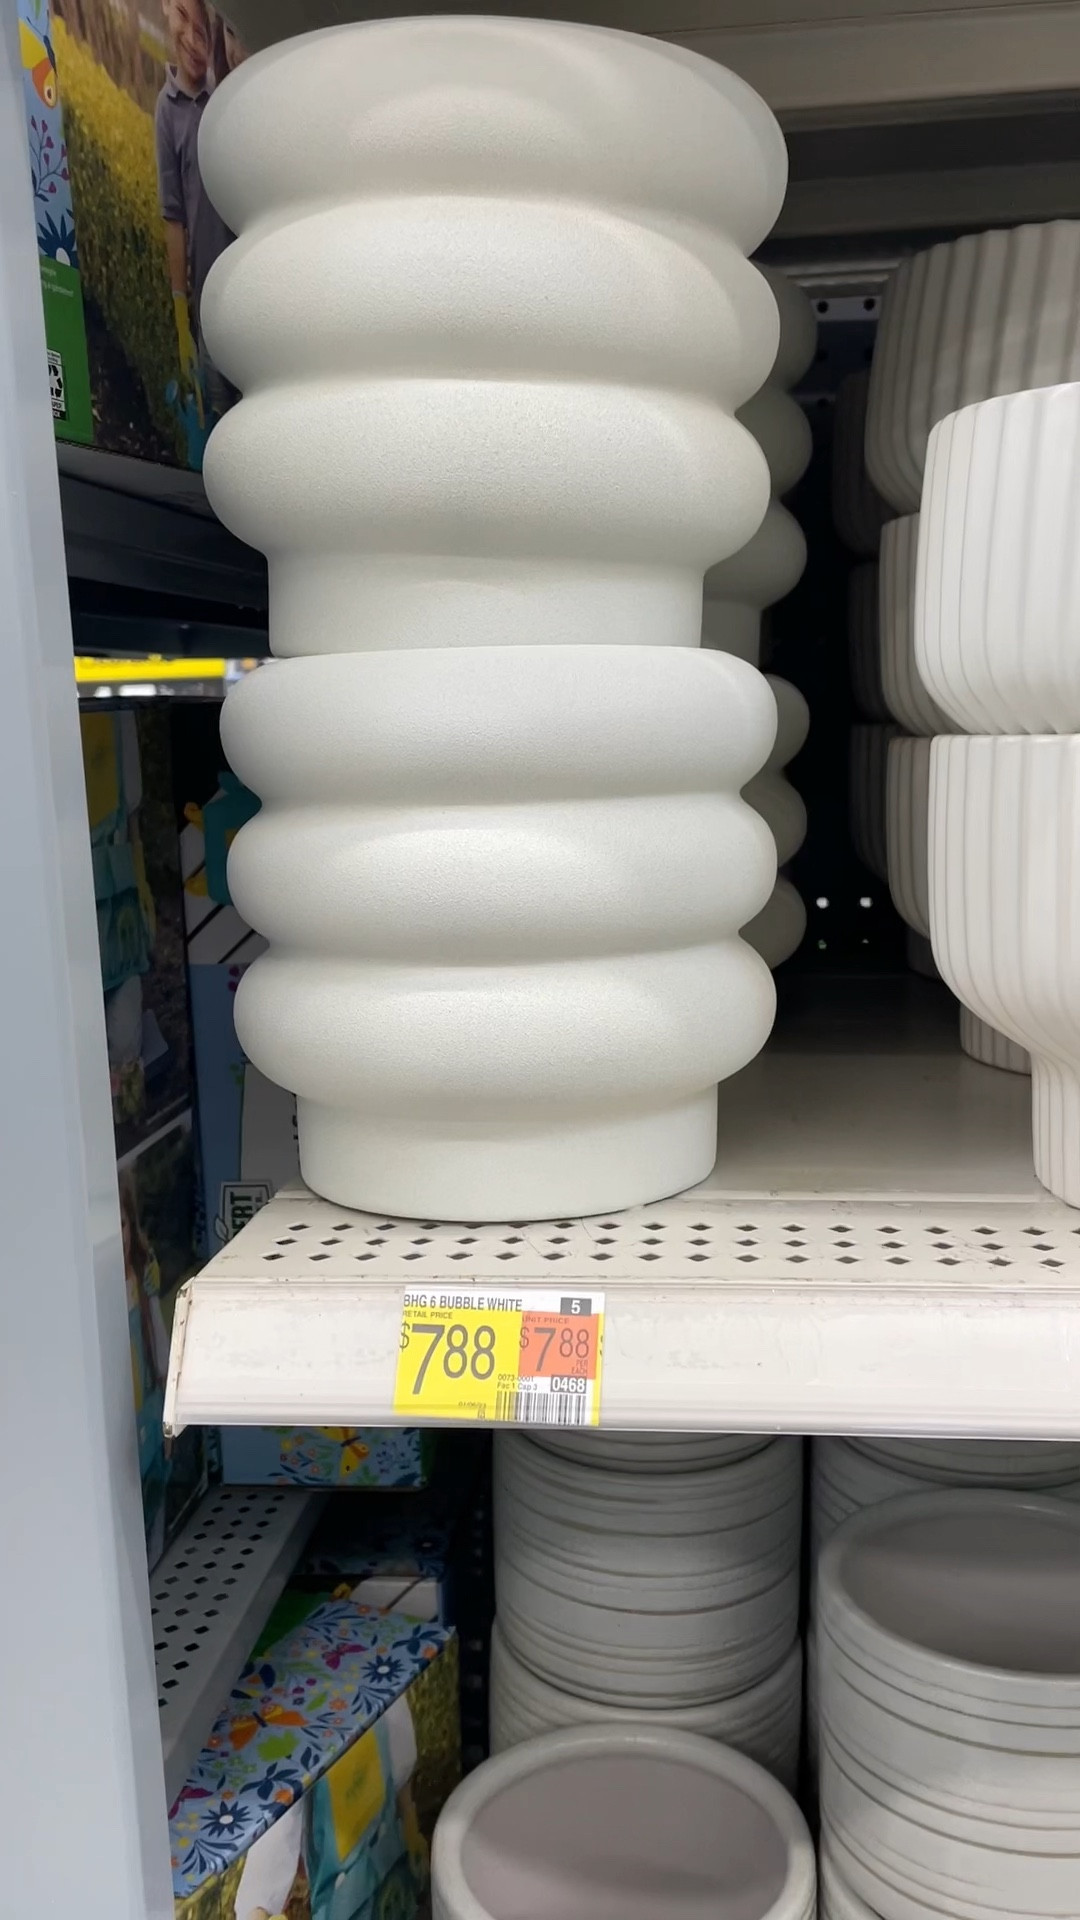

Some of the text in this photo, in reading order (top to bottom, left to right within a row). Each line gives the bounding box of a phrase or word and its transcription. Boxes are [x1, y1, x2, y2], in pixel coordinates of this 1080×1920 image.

[403, 1294, 523, 1312] BHG 6 BUBBLE WHITE
[570, 1299, 581, 1315] 5
[403, 1310, 453, 1319] RETAIL PRICE
[544, 1316, 569, 1324] PRICE
[517, 1383, 531, 1391] Cap
[552, 1376, 586, 1393] 0468
